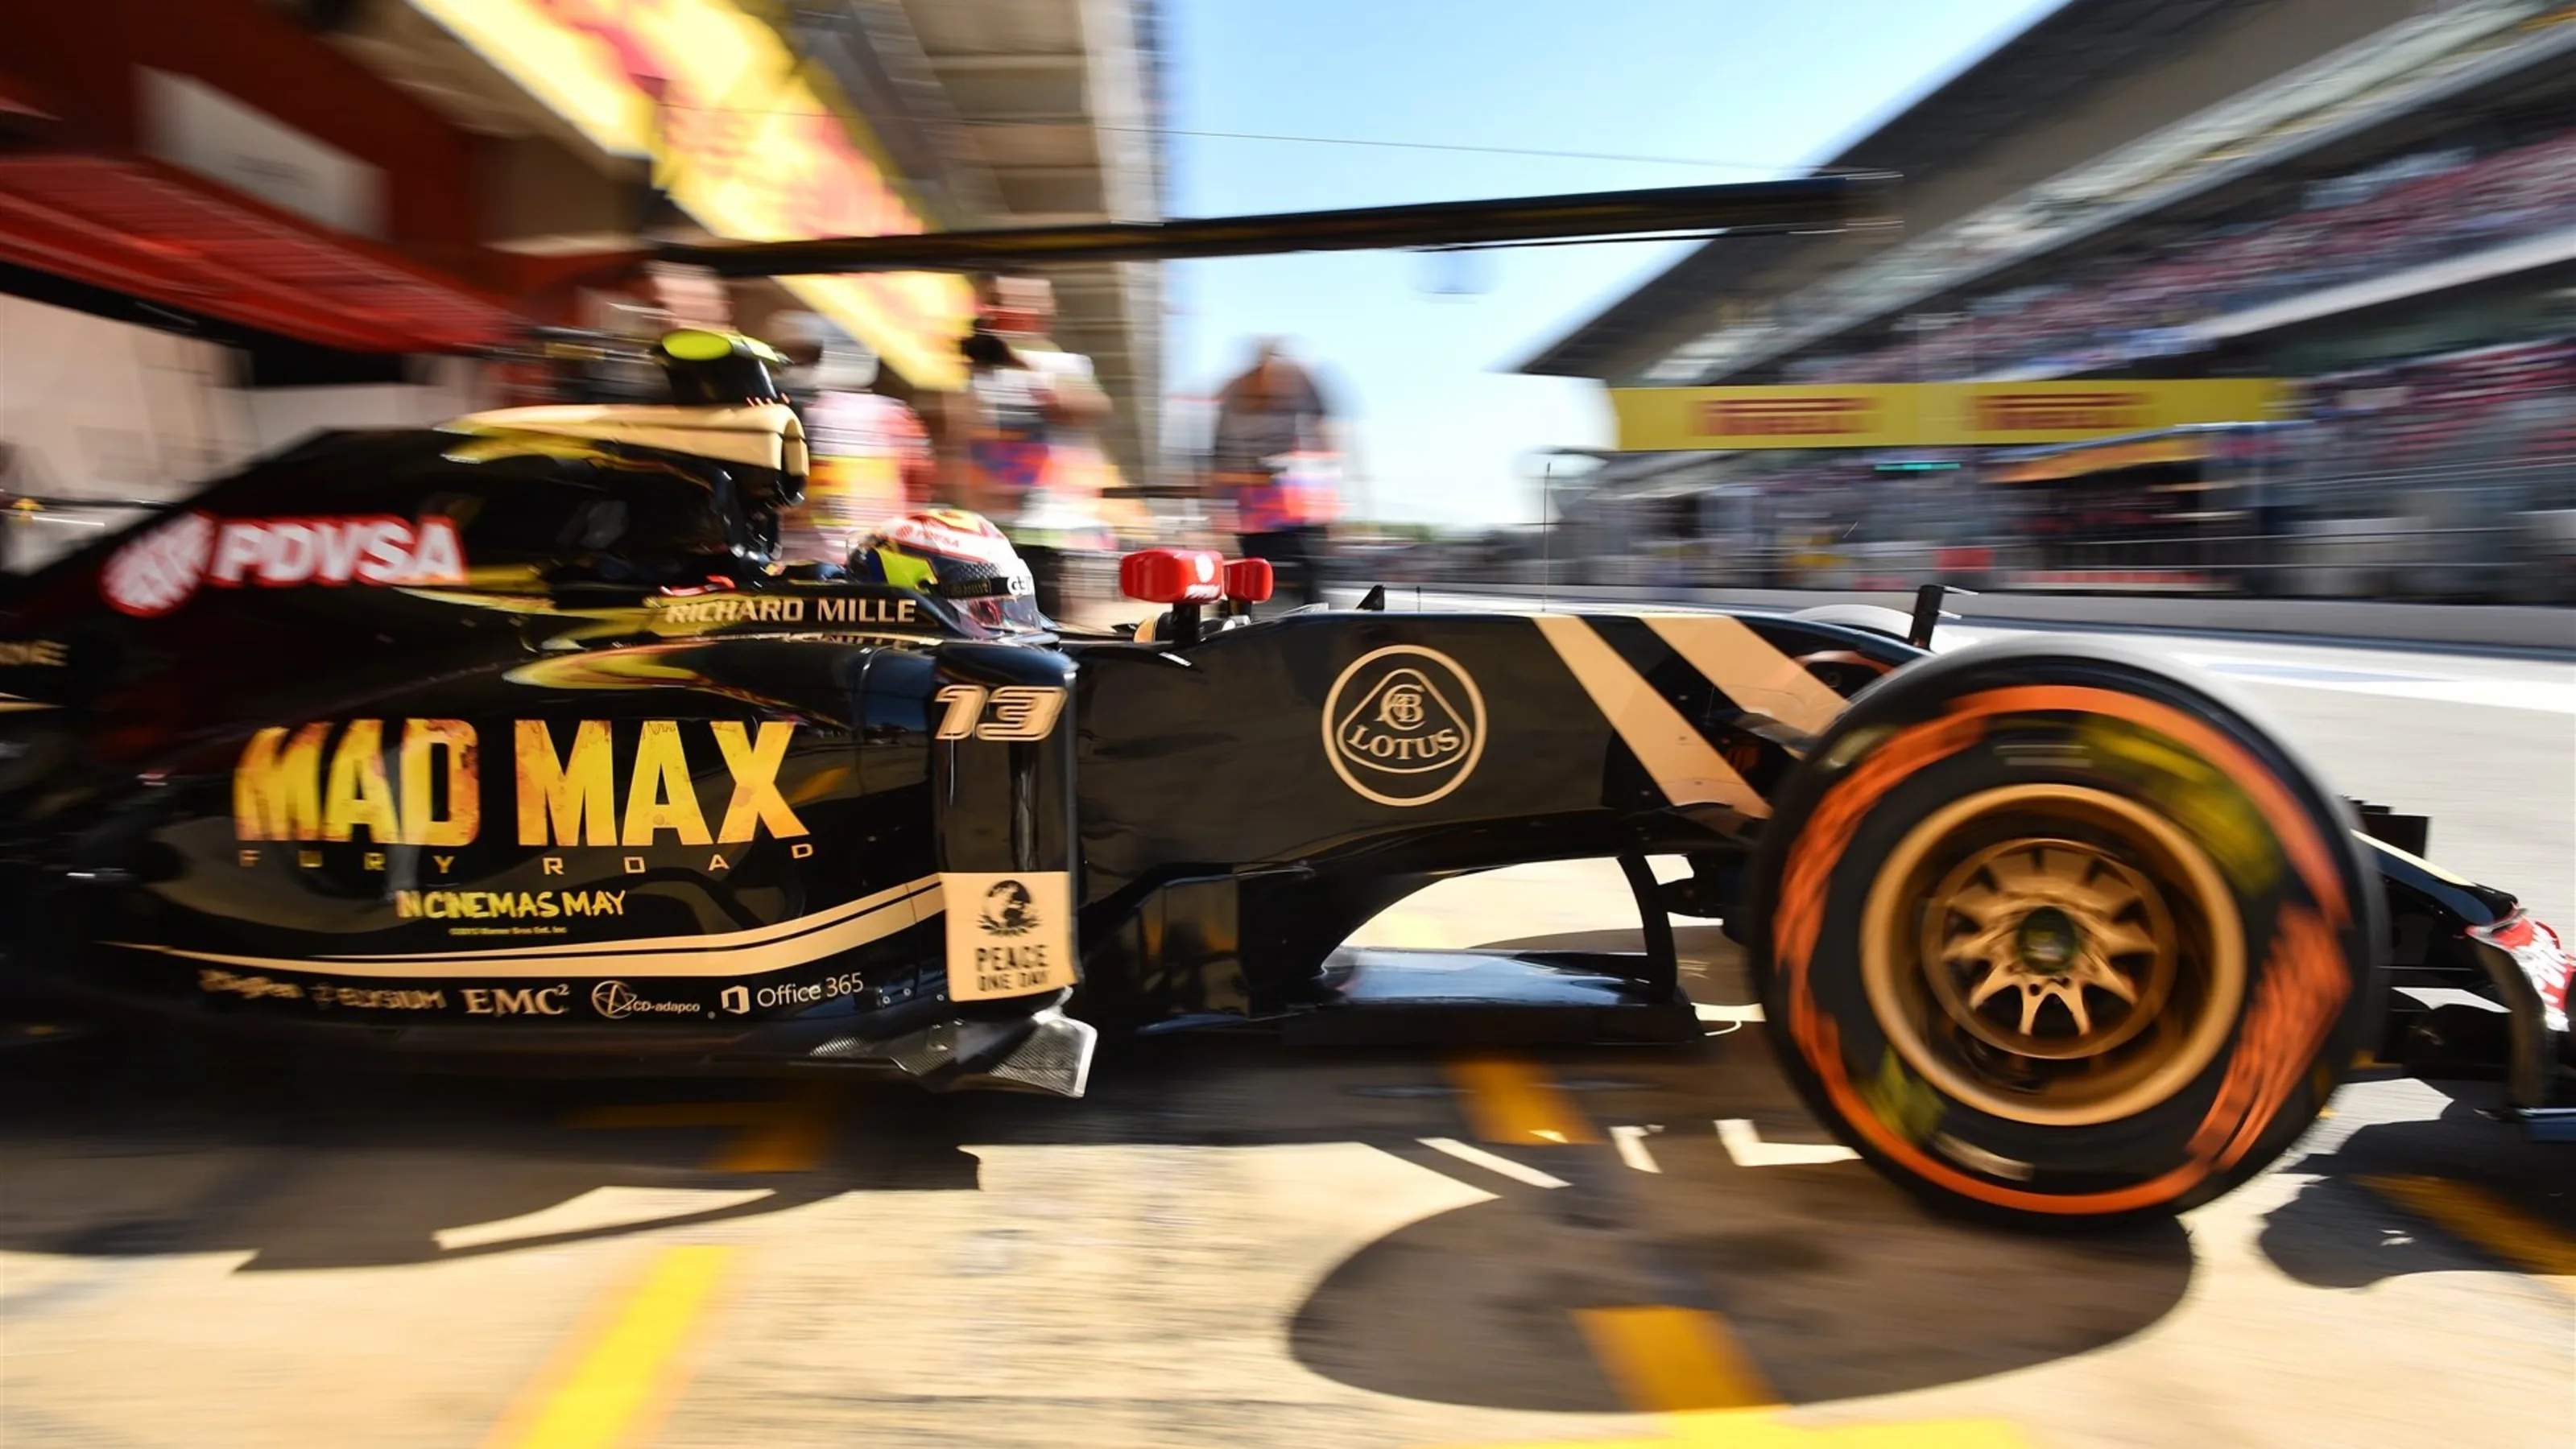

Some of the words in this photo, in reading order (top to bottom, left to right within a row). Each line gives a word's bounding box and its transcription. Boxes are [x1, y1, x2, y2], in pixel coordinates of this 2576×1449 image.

[209, 520, 464, 584] PDVSA
[665, 598, 804, 624] RICHARD
[817, 599, 916, 622] MILLE
[934, 683, 1069, 741] 13
[1347, 724, 1461, 760] LOTUS
[234, 719, 480, 846] MAD
[515, 719, 810, 847] MAX
[238, 849, 455, 873] FURY
[543, 843, 813, 875] ROAD
[424, 890, 560, 919] CINEMAS
[561, 890, 626, 917] MAY
[975, 943, 1049, 972] PEACE
[757, 982, 821, 1008] Office
[825, 972, 864, 997] 365
[977, 974, 1013, 992] ONE
[1017, 969, 1050, 988] DAY
[633, 1000, 701, 1013] CD-adapco
